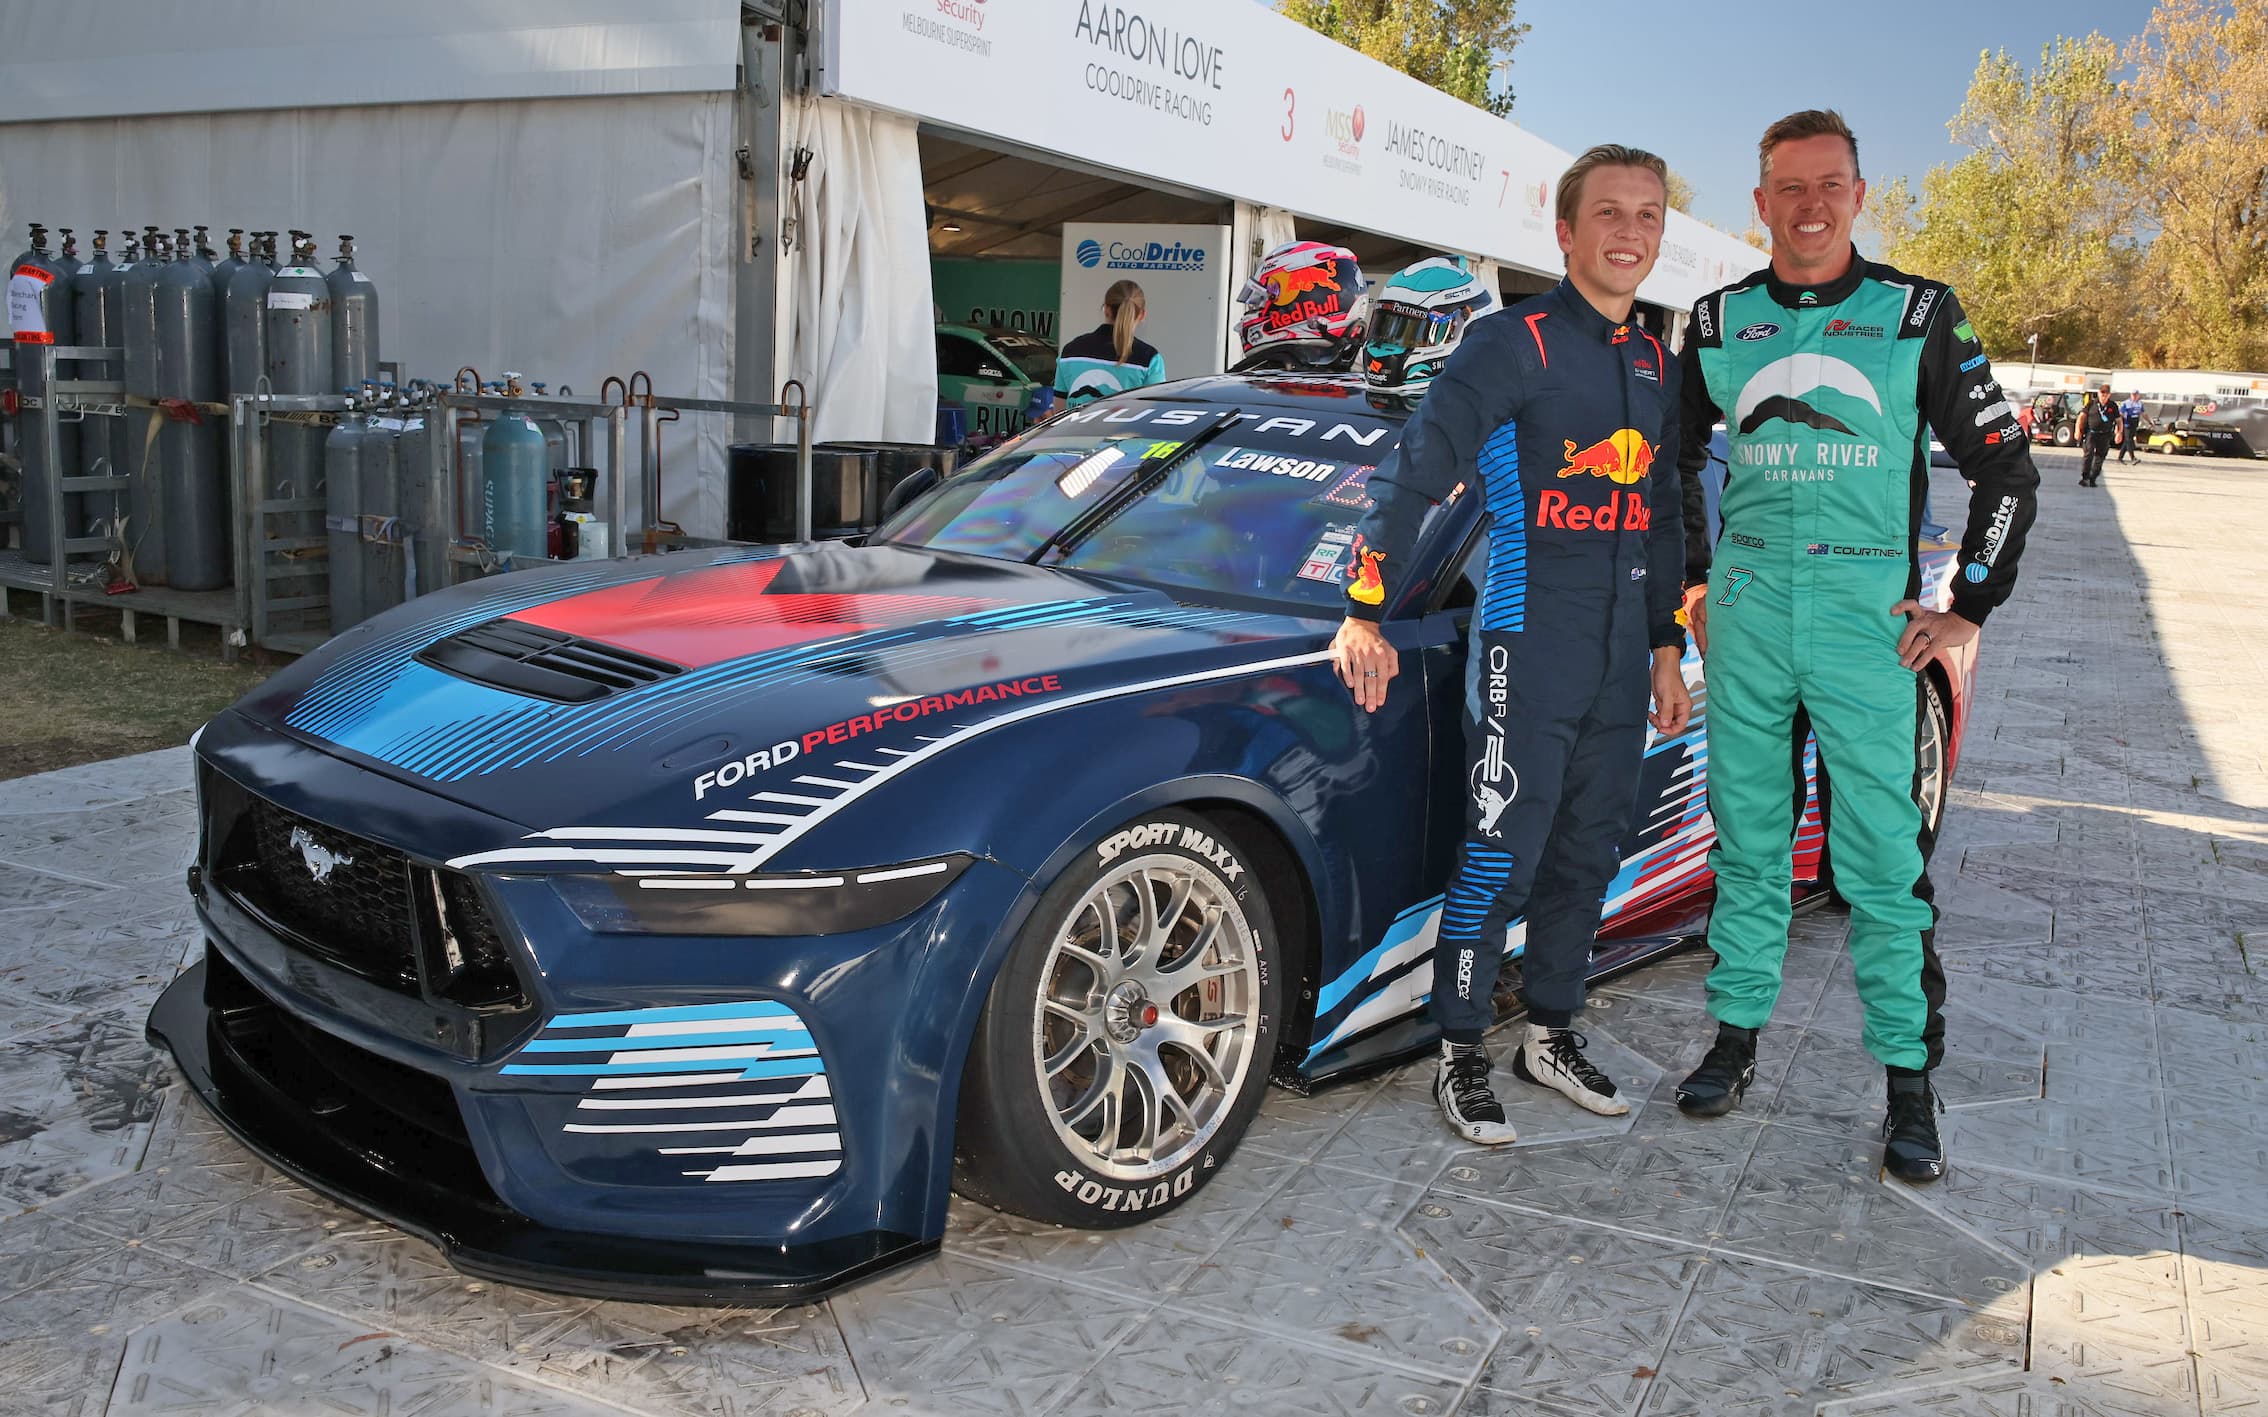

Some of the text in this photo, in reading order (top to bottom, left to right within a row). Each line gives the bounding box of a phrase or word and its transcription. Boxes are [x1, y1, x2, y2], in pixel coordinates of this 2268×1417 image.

[937, 0, 984, 30] security
[902, 12, 992, 56] MELBOURNE SUPERSPRINT
[1075, 0, 1223, 90] AARON LOVE
[1086, 63, 1211, 126] COOLDRIVE RACING
[1281, 87, 1295, 142] 3
[1385, 119, 1485, 182] JAMES COURTNEY
[1400, 169, 1470, 206] SNOWY RIVER RACING
[1499, 170, 1510, 209] 7
[1109, 242, 1205, 261] CoolDrive
[1270, 293, 1339, 329] Red Bull
[1392, 301, 1428, 319] Partners
[1910, 288, 1938, 328] sparco
[1742, 324, 1772, 340] Ford
[976, 406, 1030, 438] RIV
[1050, 407, 1401, 450] MUSTAN
[1139, 441, 1184, 459] 16
[1214, 446, 1336, 482] Lawson
[1817, 442, 1879, 467] RIVER
[1764, 469, 1835, 481] CARAVANS
[1536, 489, 1651, 531] Red Bu
[1731, 533, 1766, 548] sparco
[1974, 495, 2011, 563] CoolDrive
[1310, 563, 1325, 576] T
[1315, 549, 1337, 558] RR
[1833, 546, 1904, 557] COURTNEY
[1719, 567, 1754, 607] 7
[1096, 822, 1246, 883] SPORT MAXX
[1235, 884, 1248, 901] 16
[1053, 1165, 1194, 1212] DUNLOP
